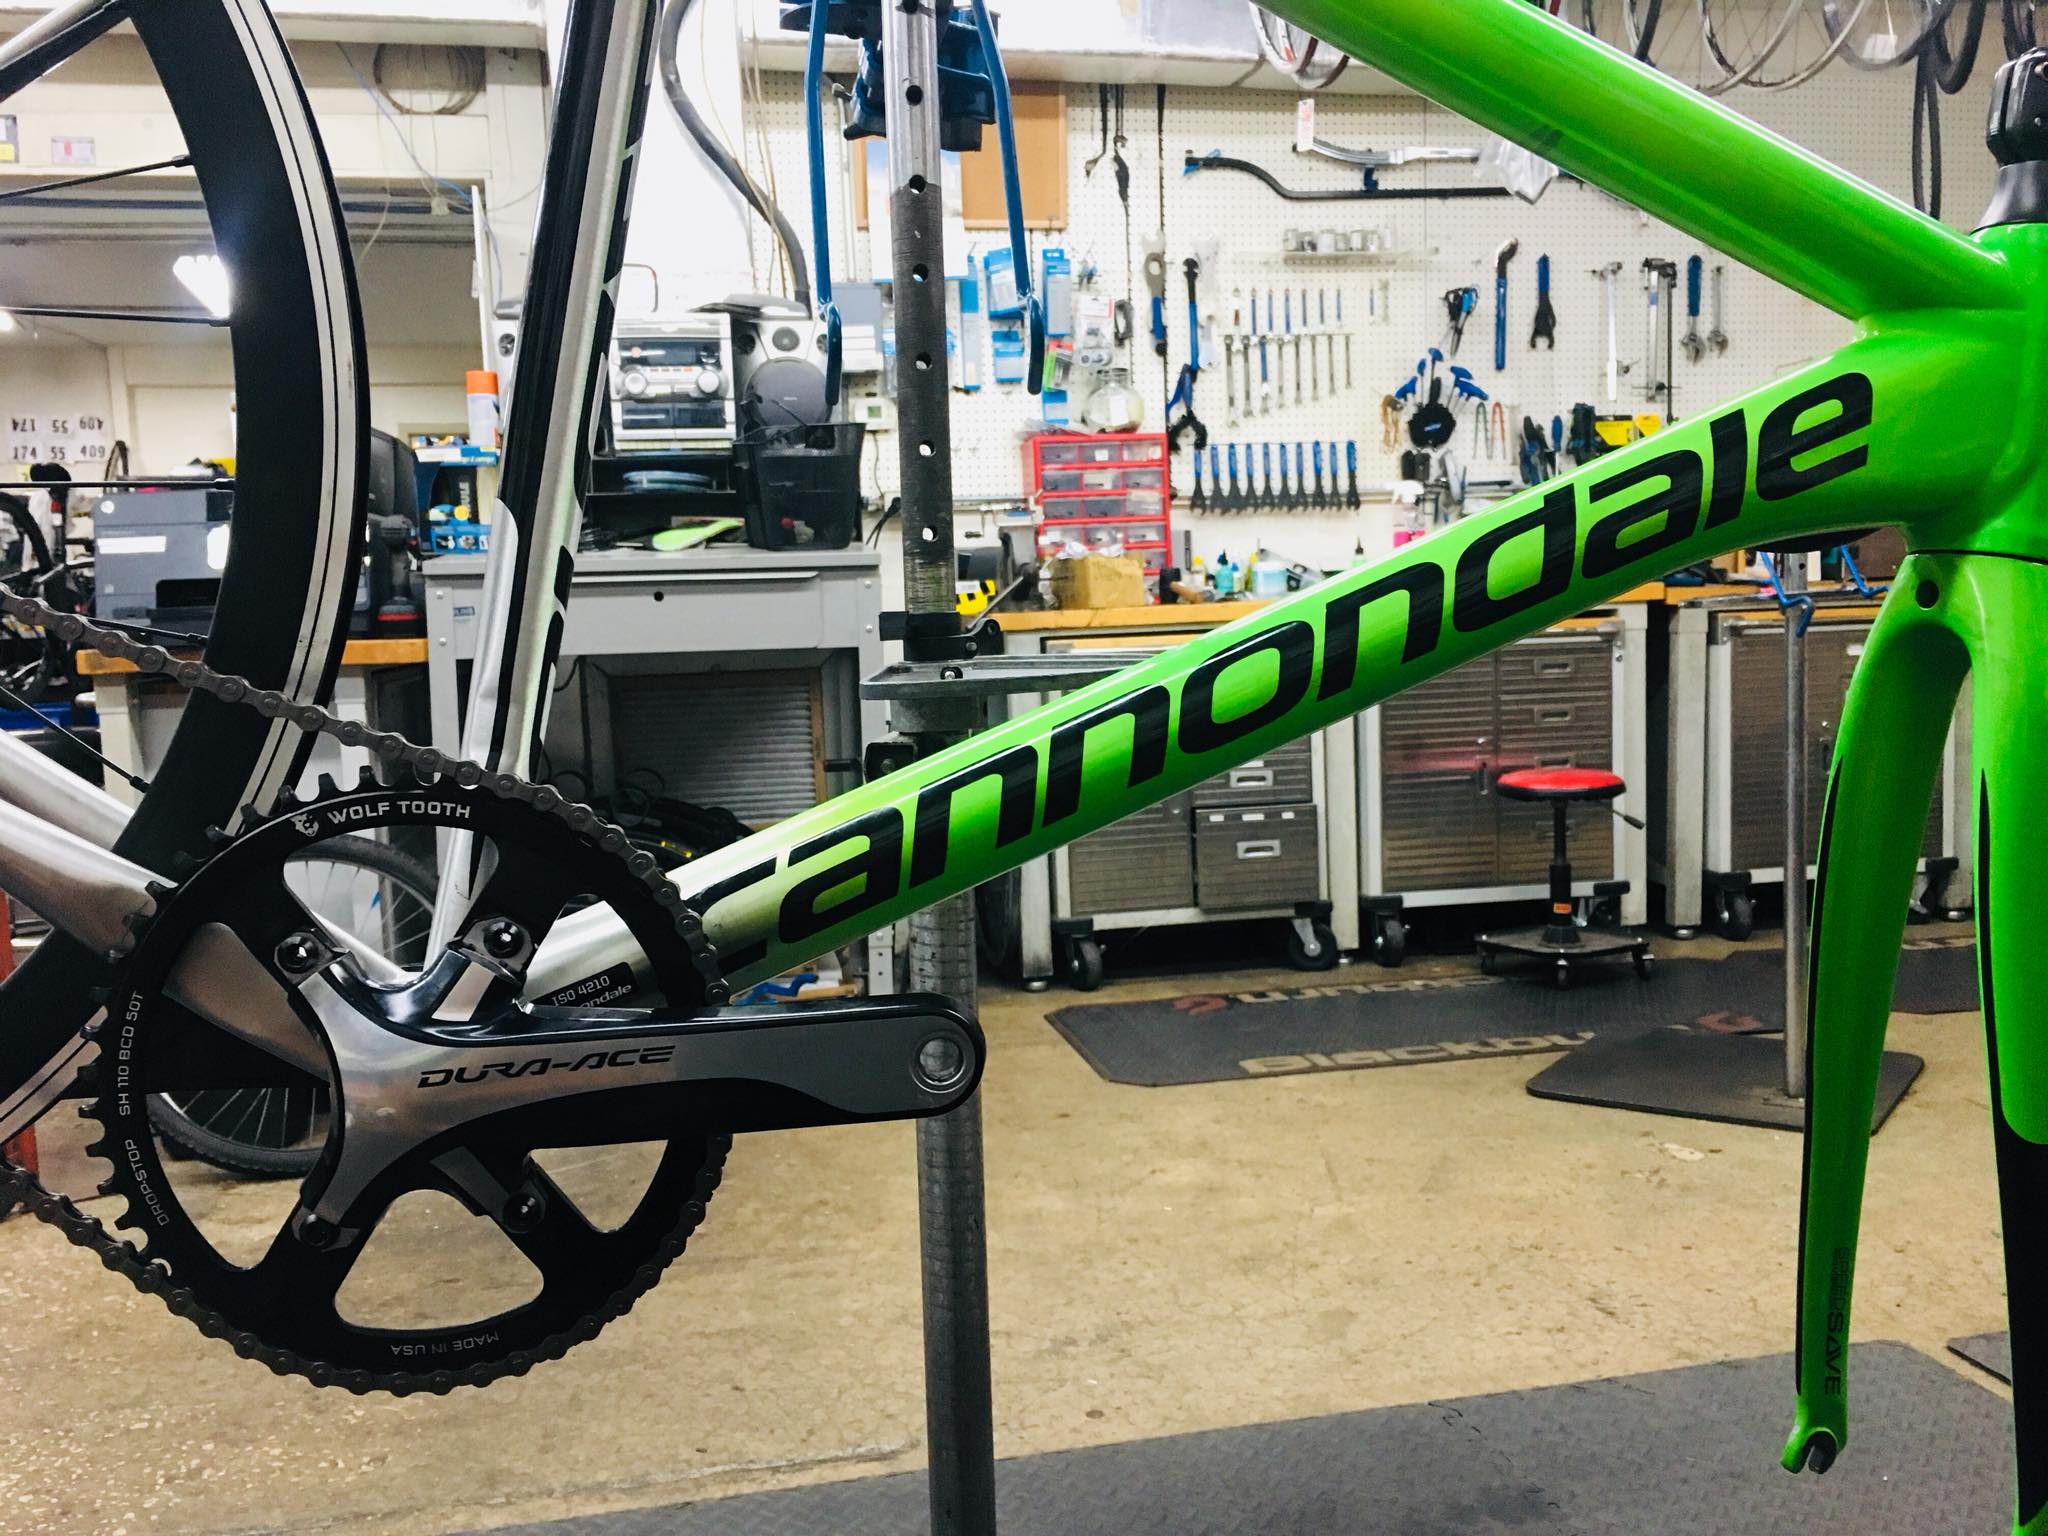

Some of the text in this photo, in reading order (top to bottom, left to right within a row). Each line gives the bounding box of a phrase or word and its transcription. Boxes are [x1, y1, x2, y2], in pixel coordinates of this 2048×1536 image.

[13, 444, 106, 460] 174 55 409
[326, 800, 471, 825] WOLF TOOTH
[551, 975, 610, 1008] ISO 4210
[117, 991, 144, 1116] SH 110 BCD 50T
[417, 1045, 676, 1089] DURA-ACE
[390, 1330, 500, 1356] MADE IN USA
